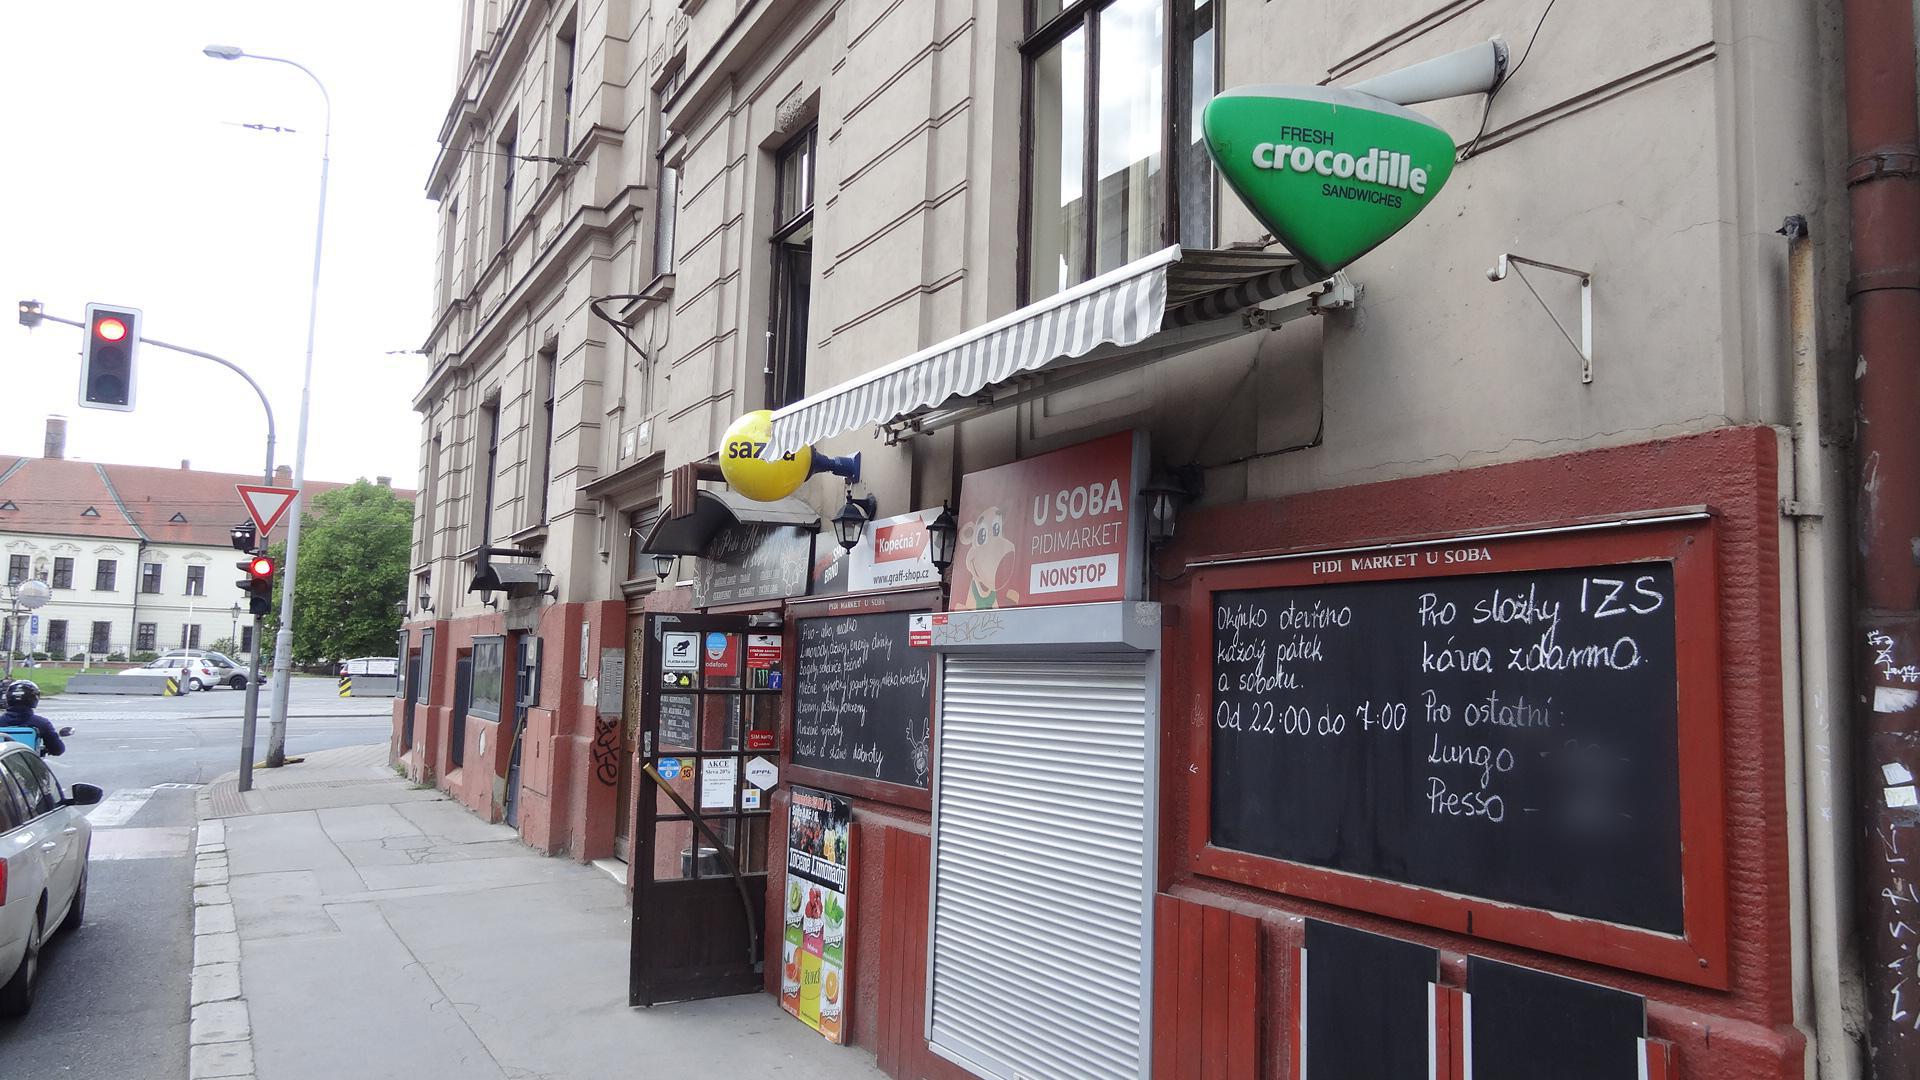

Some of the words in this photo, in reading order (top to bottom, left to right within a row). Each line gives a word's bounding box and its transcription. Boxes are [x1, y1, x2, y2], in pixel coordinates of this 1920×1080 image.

[1281, 126, 1334, 146] FRESH
[1252, 142, 1428, 195] crocodille
[1321, 184, 1403, 209] SANDWICHES
[729, 441, 796, 461] saza
[1033, 494, 1049, 526] U
[1055, 478, 1123, 523] SOBA
[879, 537, 913, 555] Kopečná
[914, 532, 921, 547] 7
[1031, 521, 1122, 555] PIDIMARKET
[873, 568, 929, 586] www.graff-shop.cz
[1039, 562, 1106, 588] NONSTOP
[1313, 559, 1342, 575] PIDI
[1352, 552, 1419, 571] MARKET
[1426, 551, 1439, 565] U
[1444, 547, 1492, 563] SOBA
[841, 600, 861, 609] MARKET
[1418, 592, 1457, 627] Pro
[1473, 583, 1561, 648] složky
[1581, 575, 1665, 618] IZS
[1217, 604, 1267, 646] Okýnko
[1279, 600, 1351, 630] otevřeno
[1217, 638, 1266, 676] každý
[1277, 633, 1323, 678] pátek
[1422, 636, 1493, 673] káva
[1218, 673, 1230, 692] a
[1217, 700, 1242, 731] Od
[1249, 701, 1311, 735] 22:00
[1318, 704, 1346, 736] do
[1356, 701, 1407, 731] 7:00
[1421, 689, 1451, 723] Pro
[707, 760, 729, 768] AKCE
[853, 742, 884, 778] dobroty
[1428, 733, 1515, 789] Lungo
[1426, 776, 1504, 823] Presso
